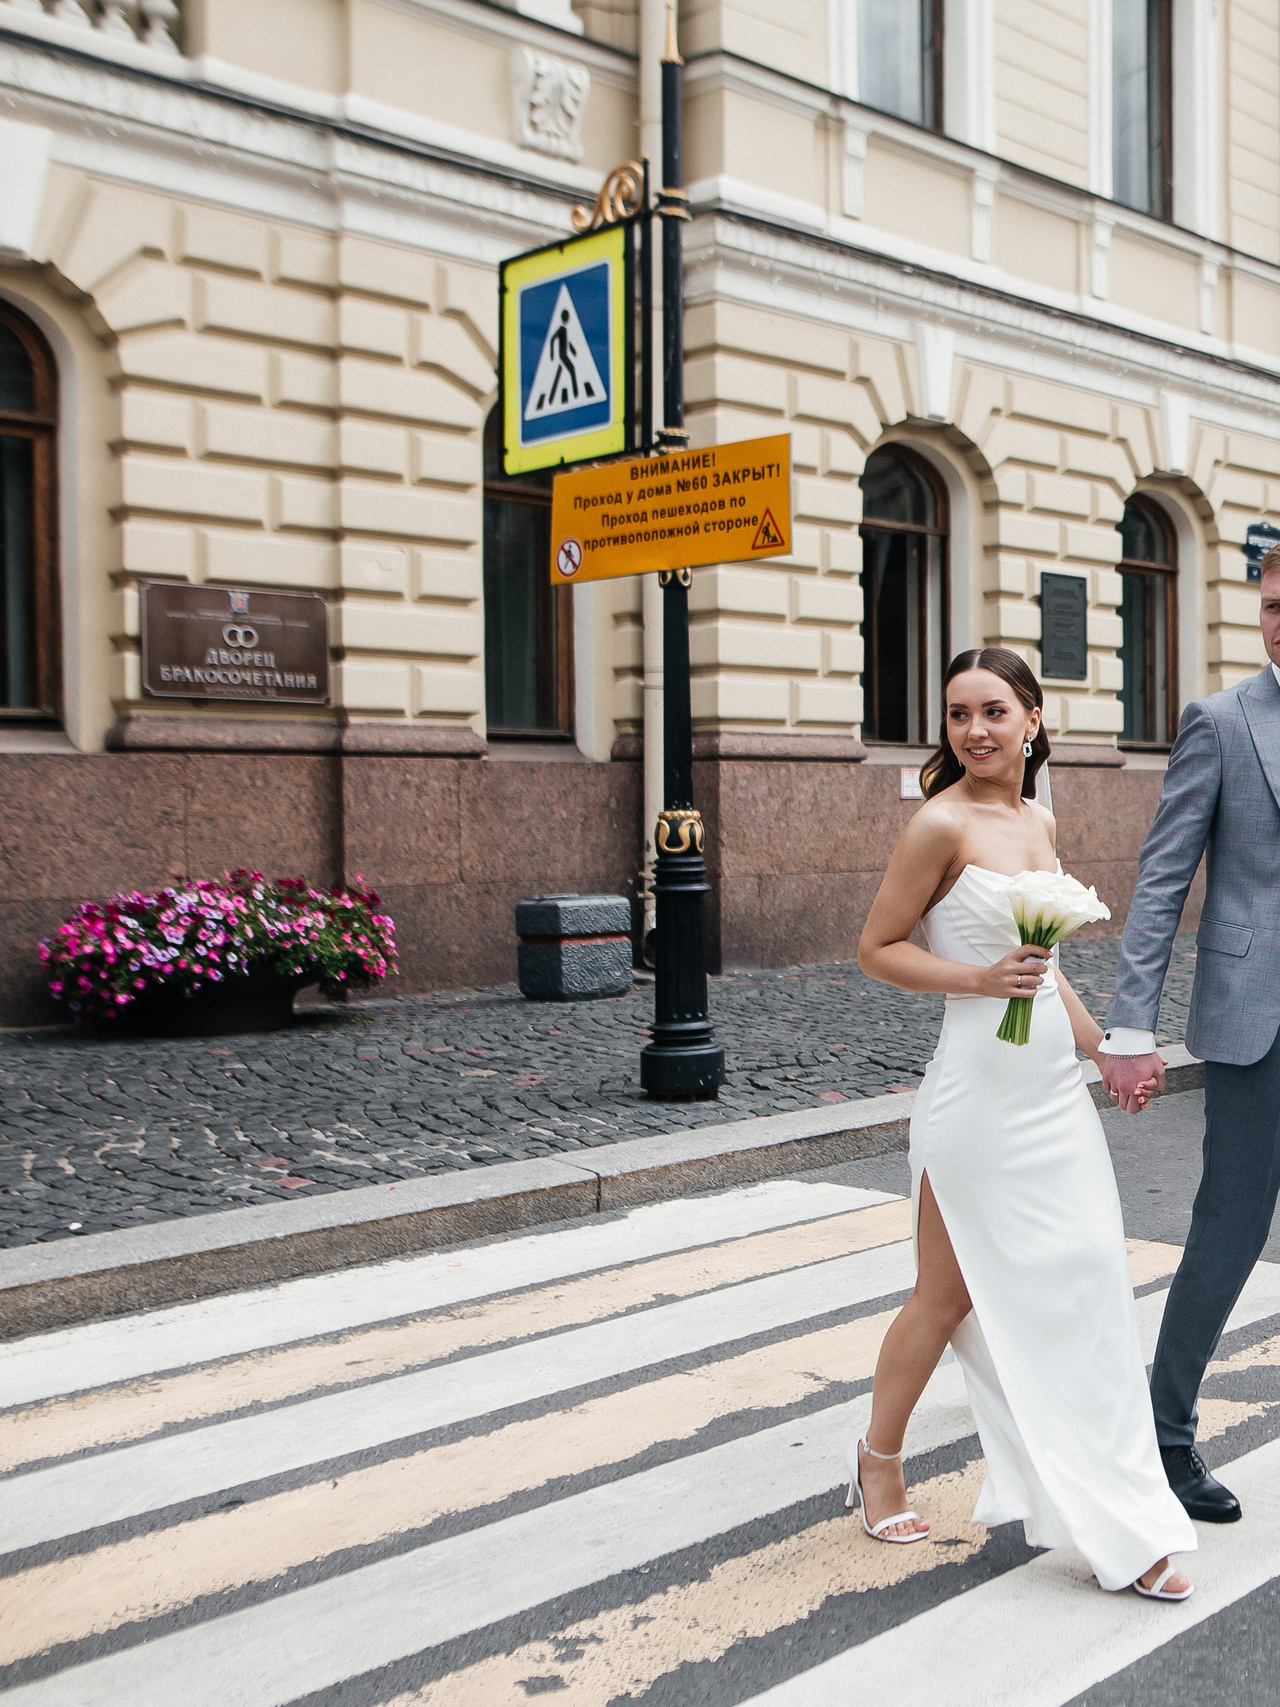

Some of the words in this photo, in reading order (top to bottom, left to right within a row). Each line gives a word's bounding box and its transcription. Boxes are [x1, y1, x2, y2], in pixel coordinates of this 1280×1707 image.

[630, 453, 716, 480] ВНИМАНИЕ!
[574, 492, 622, 512] Проход
[627, 491, 633, 504] у
[637, 484, 672, 501] дома
[677, 476, 708, 493] №60
[712, 463, 780, 488] ЗАКРЫТ!
[602, 511, 648, 529] Проход
[652, 499, 726, 520] пешеходов
[730, 496, 746, 508] по
[583, 521, 700, 551] противоположной
[703, 516, 758, 533] стороне
[205, 648, 276, 668] ДВОРЕЦ
[160, 665, 317, 688] БРАКОСОЧЕТАНИЯ
